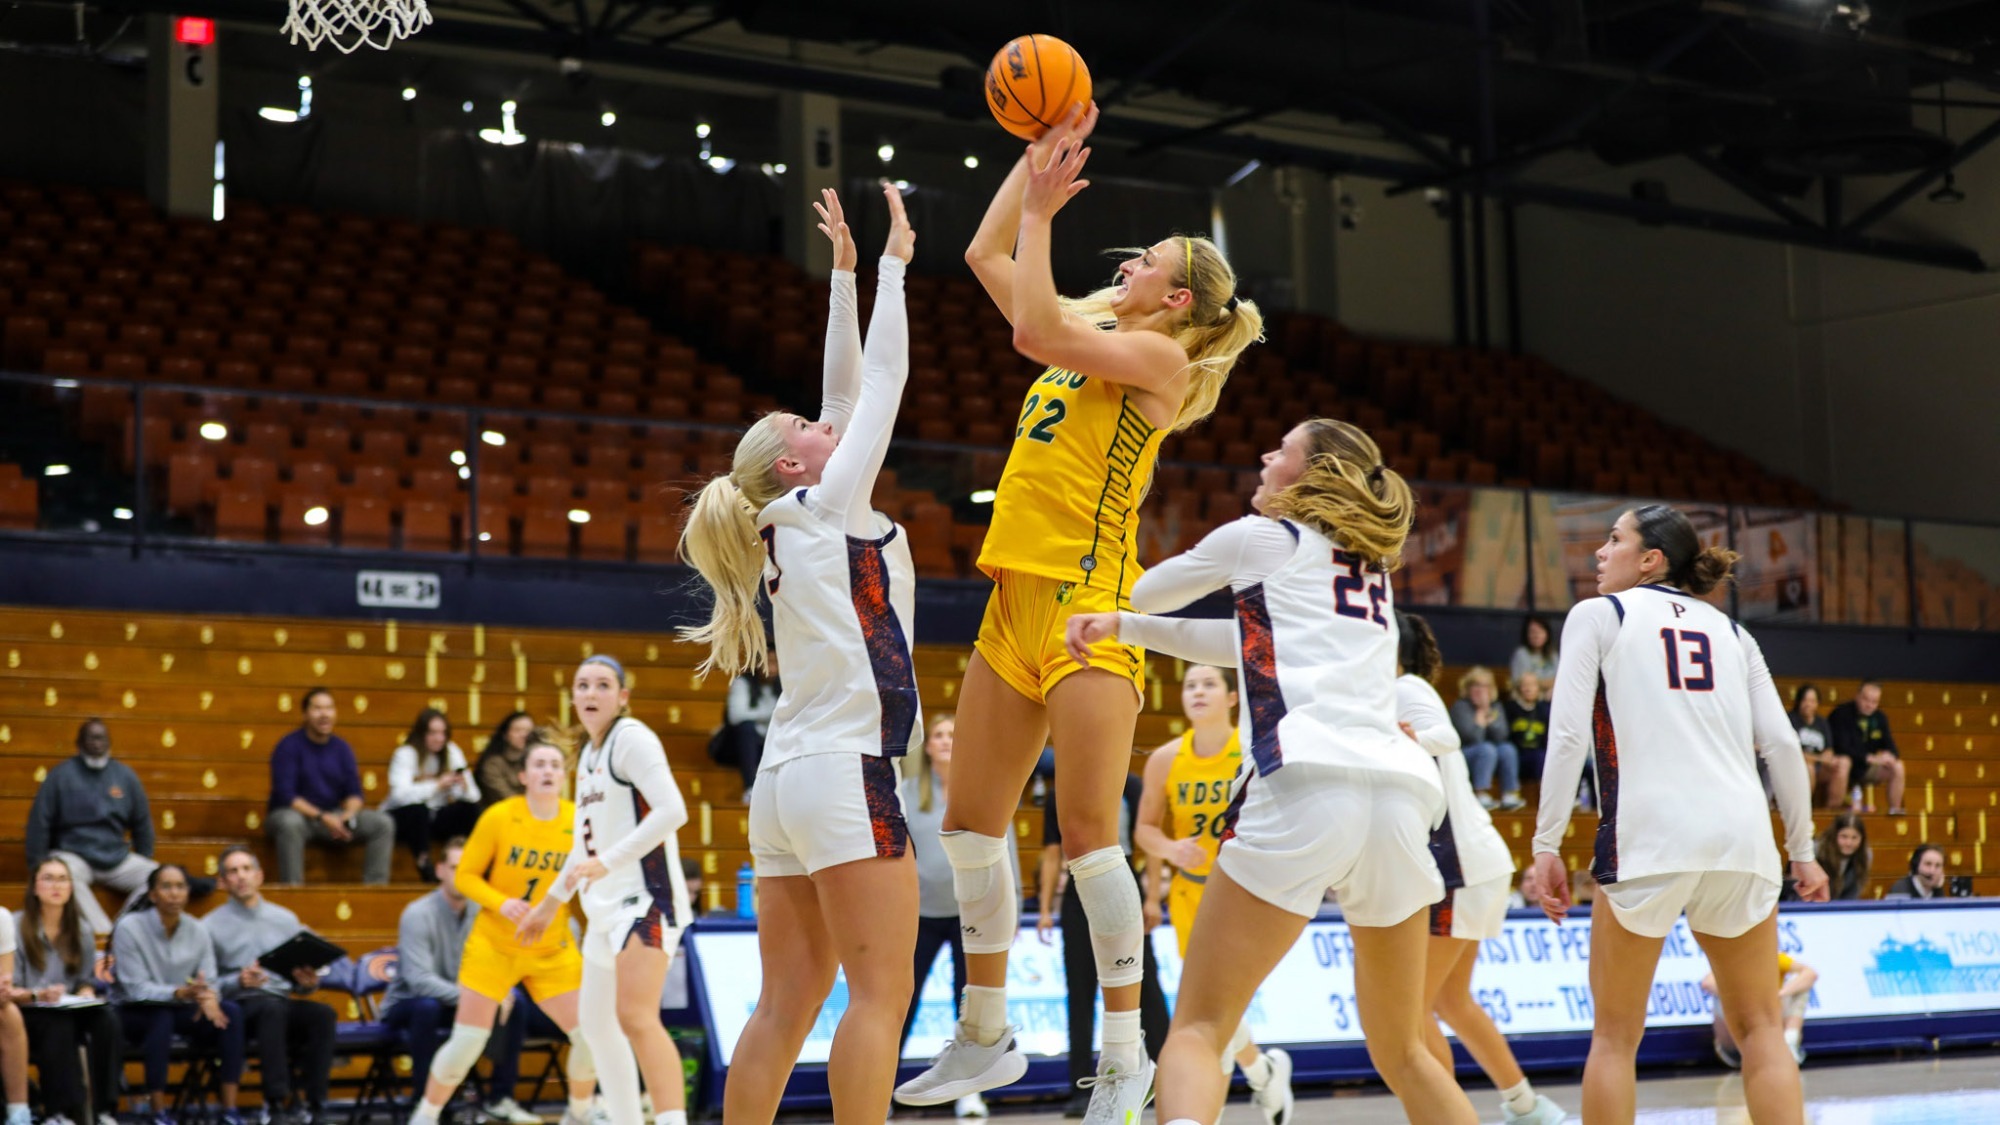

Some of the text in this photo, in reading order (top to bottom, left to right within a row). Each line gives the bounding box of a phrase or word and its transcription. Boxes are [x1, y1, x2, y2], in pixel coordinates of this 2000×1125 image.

[1015, 393, 1068, 445] 22
[1666, 600, 1687, 618] P
[1659, 627, 1715, 692] 13
[583, 815, 598, 858] 2
[1189, 811, 1230, 840] 30
[506, 845, 565, 873] NDSU
[521, 876, 541, 902] 1
[1525, 927, 1551, 962] OF
